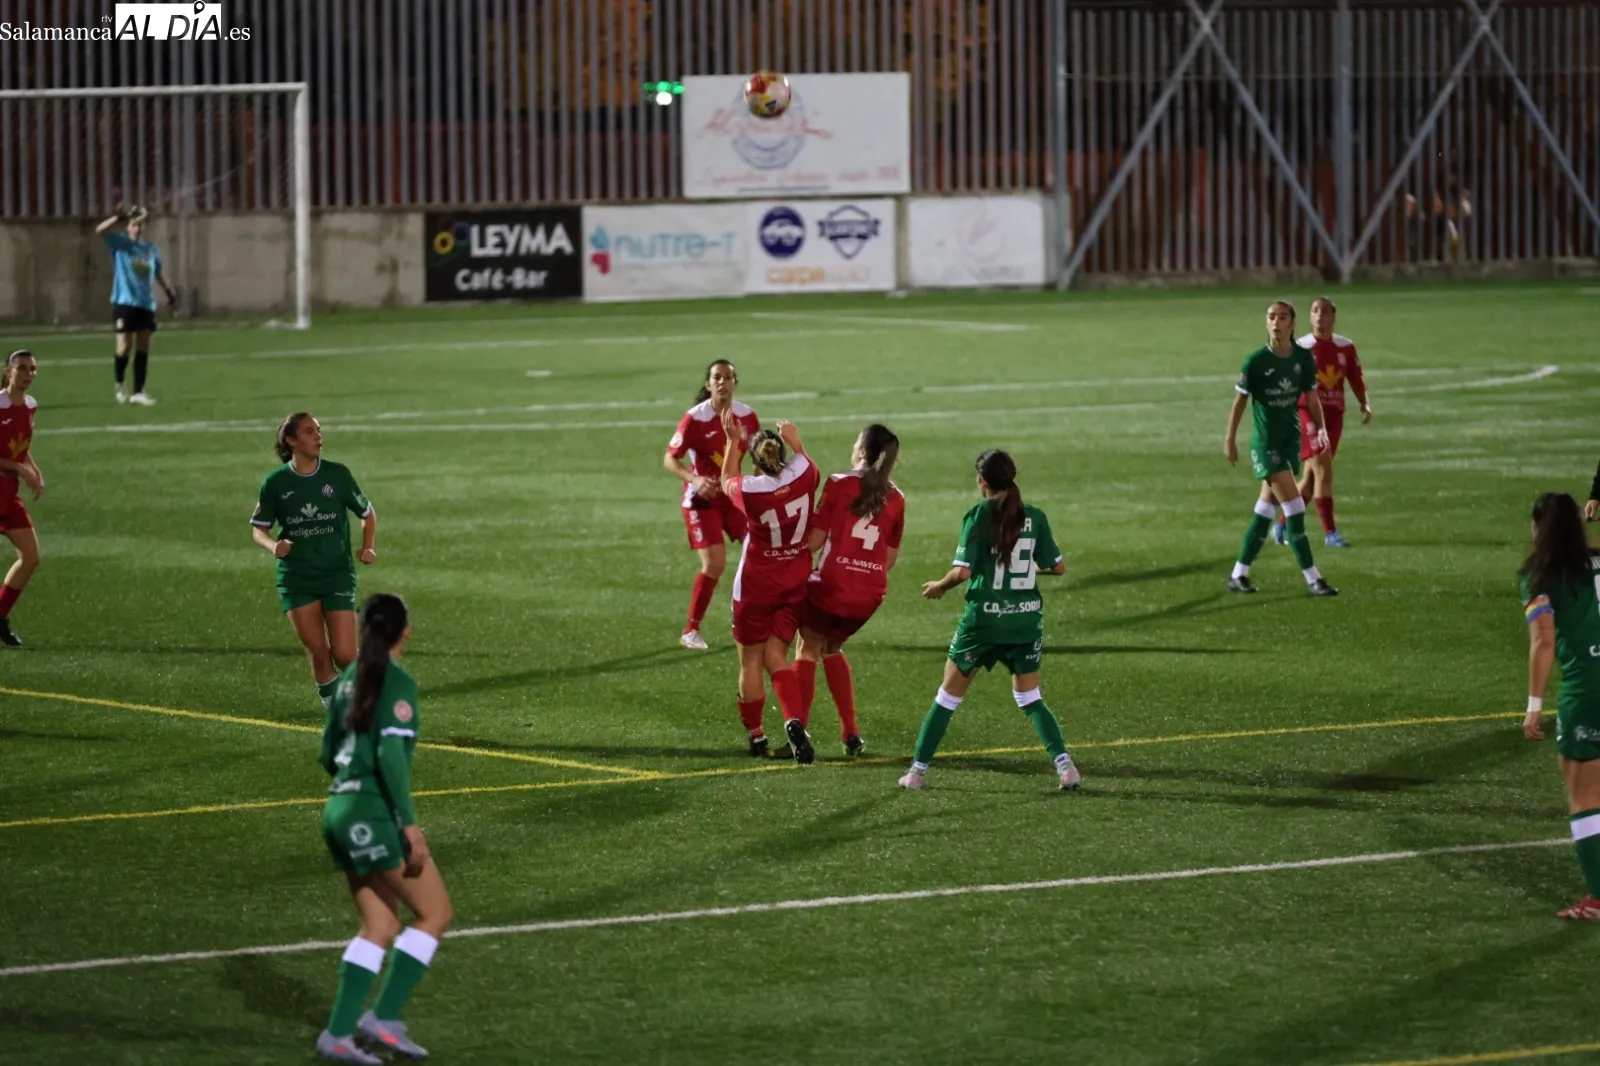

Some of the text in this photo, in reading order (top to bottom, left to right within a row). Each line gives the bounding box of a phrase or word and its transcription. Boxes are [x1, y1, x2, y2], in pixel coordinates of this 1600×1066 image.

[470, 222, 573, 258] LEYMA
[454, 265, 549, 292] Café-Bar
[759, 492, 810, 548] 17
[851, 511, 880, 550] 4
[852, 558, 884, 572] NAVEGA
